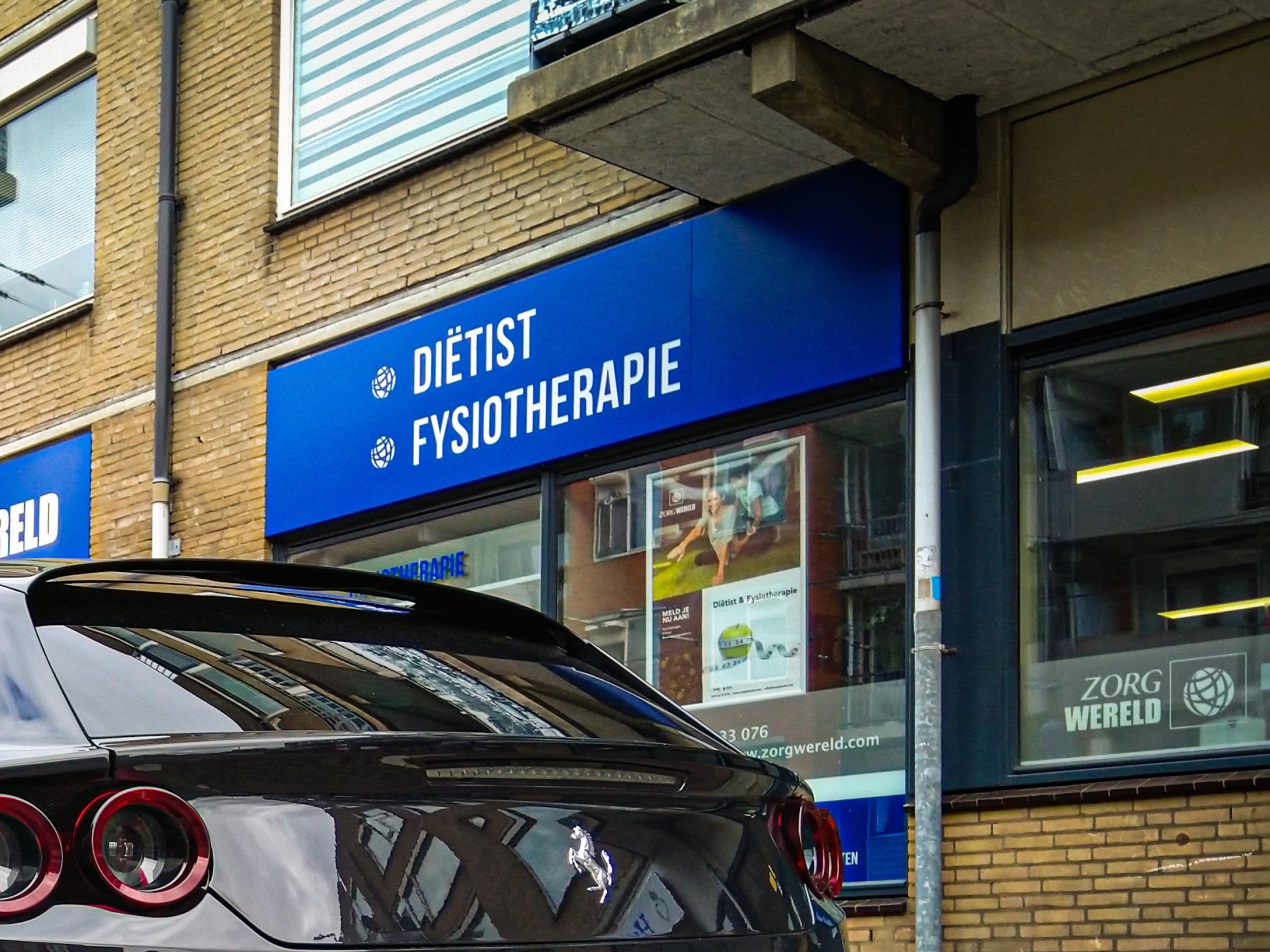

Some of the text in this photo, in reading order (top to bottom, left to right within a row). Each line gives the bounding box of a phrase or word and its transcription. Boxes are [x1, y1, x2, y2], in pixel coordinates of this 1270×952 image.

[413, 308, 537, 395] DIËTIST
[412, 338, 681, 466] FYSIOTHERAPIE
[738, 596, 744, 604] &
[746, 587, 798, 604] Fysiotherapie
[662, 608, 681, 617] MELD
[673, 613, 690, 622] AAN!
[1081, 669, 1163, 701] ZORG
[1064, 698, 1162, 732] WERELD
[741, 724, 769, 741] 076
